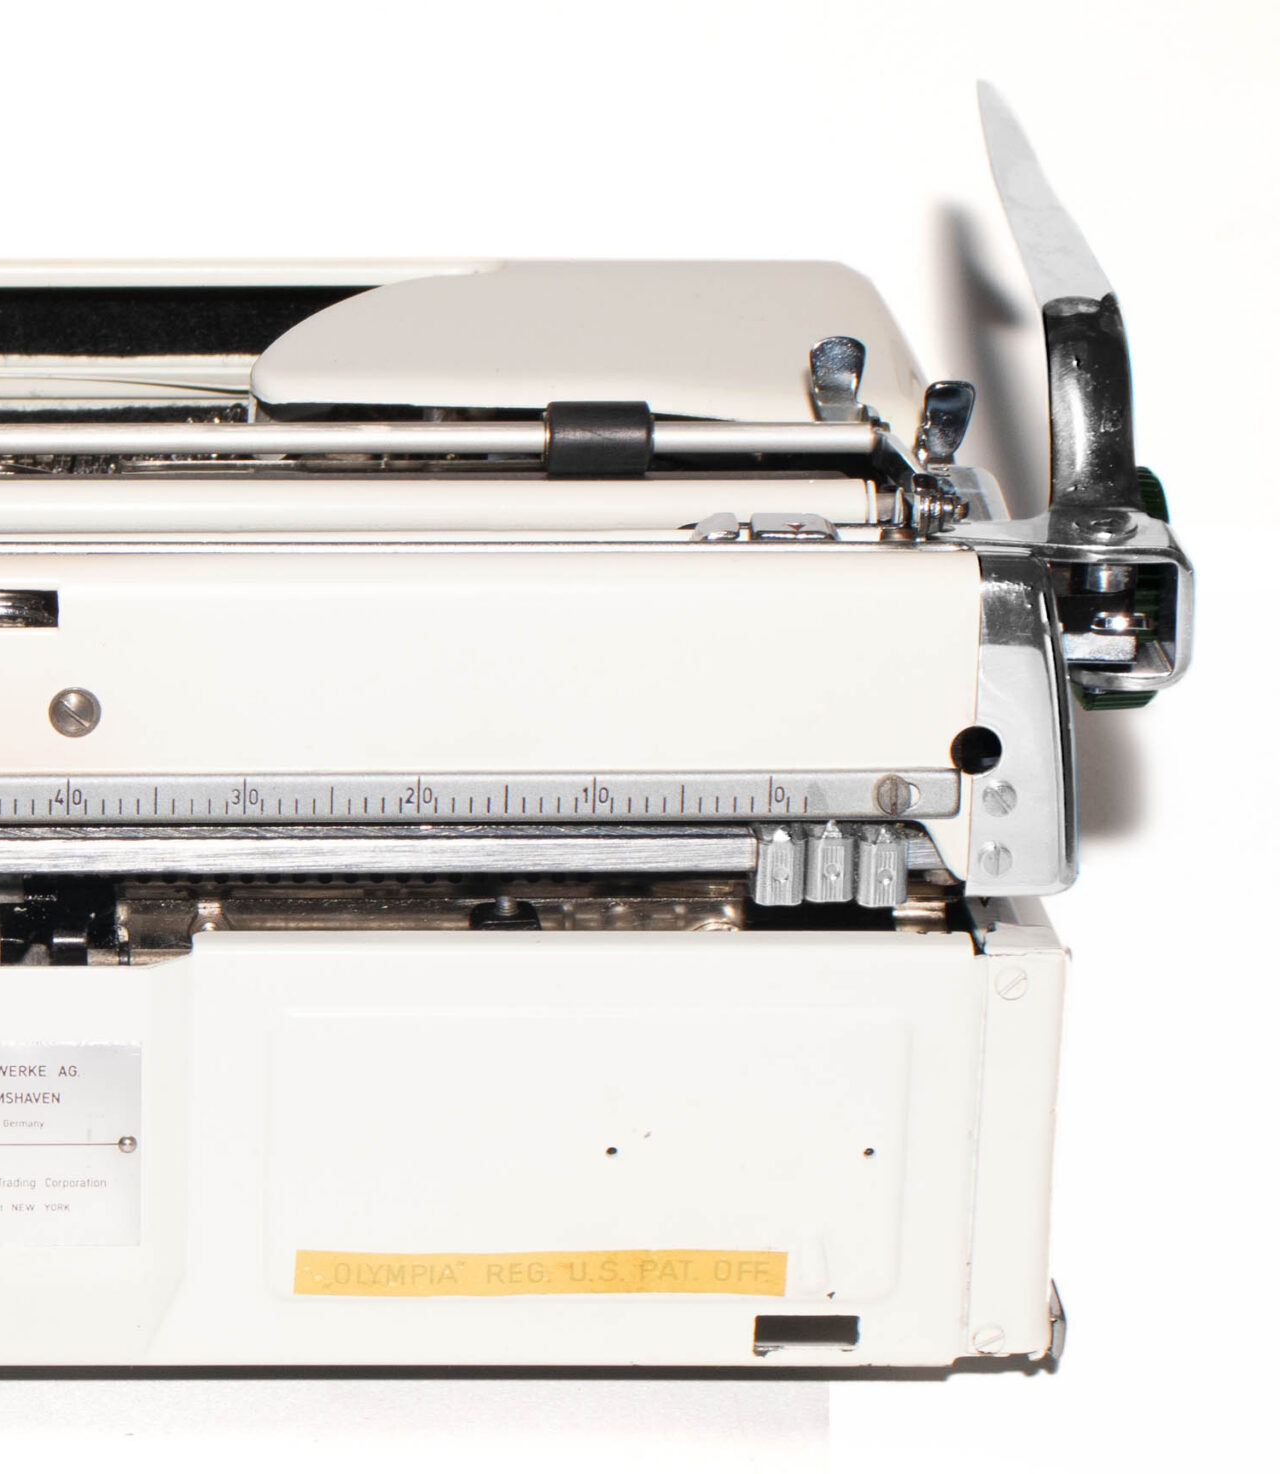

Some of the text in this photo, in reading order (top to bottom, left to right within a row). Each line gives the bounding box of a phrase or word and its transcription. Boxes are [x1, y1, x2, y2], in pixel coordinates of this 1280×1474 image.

[54, 789, 82, 806] 40
[231, 788, 259, 806] 30
[405, 787, 433, 804] 20
[582, 786, 609, 804] 10
[58, 1065, 80, 1078] AG.
[3, 1119, 45, 1129] Germany
[45, 1177, 107, 1190] Corporation
[11, 1203, 35, 1212] NEW
[45, 1203, 70, 1212] YORK
[486, 1261, 551, 1286] REG.
[570, 1260, 625, 1283] U.S.
[639, 1259, 698, 1282] PAT.
